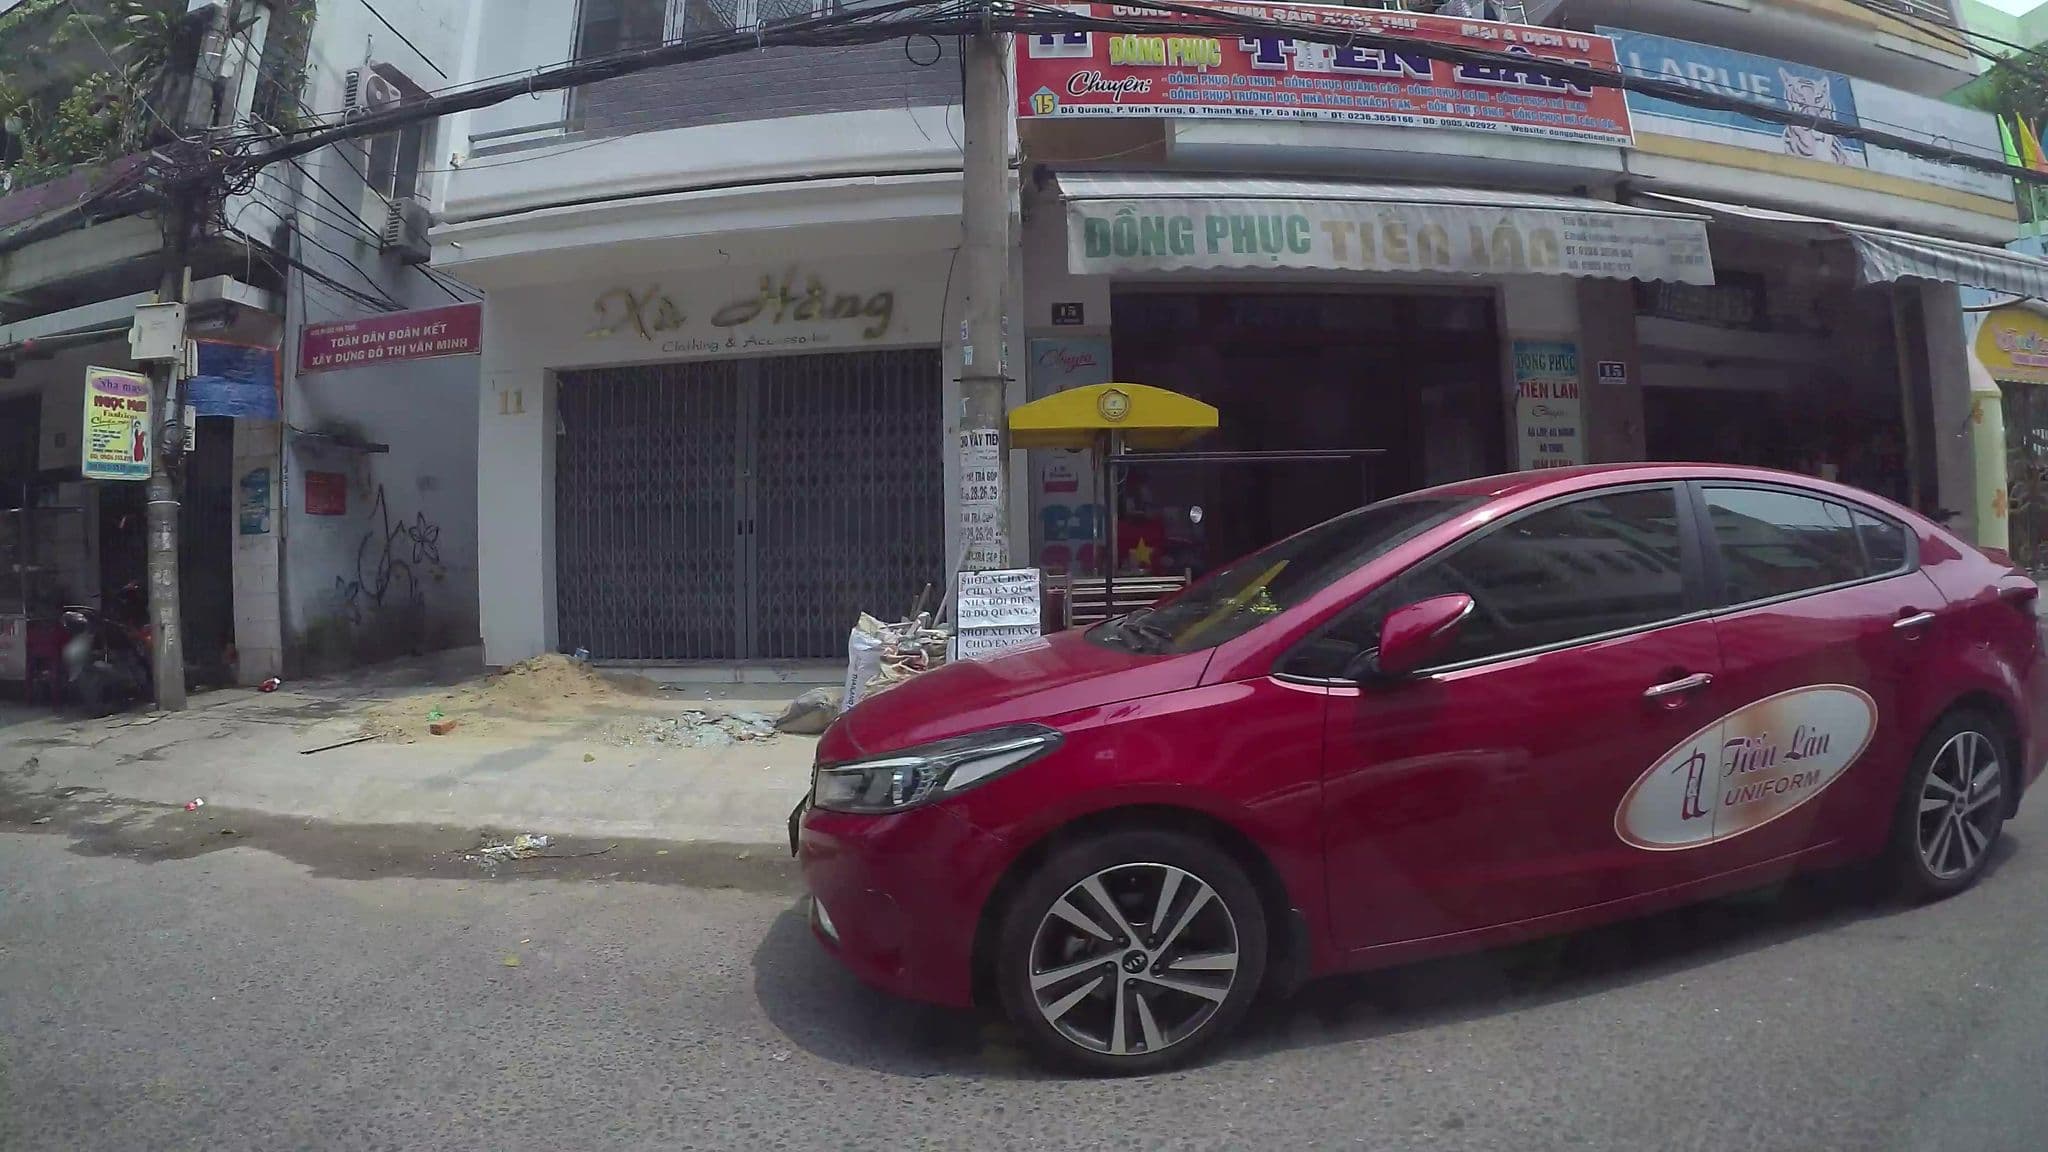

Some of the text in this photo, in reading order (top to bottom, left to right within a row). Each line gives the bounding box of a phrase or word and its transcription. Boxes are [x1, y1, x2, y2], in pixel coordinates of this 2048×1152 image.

[1167, 37, 1222, 72] PHỤC
[1067, 70, 1152, 103] Chuyên:
[1627, 52, 1776, 103] LARUE
[1035, 93, 1055, 115] 15
[1084, 207, 1195, 259] ĐỒNG
[1205, 213, 1311, 262] PHỤC
[423, 320, 448, 336] KẾT
[436, 337, 468, 350] MINH
[661, 335, 719, 353] Clothing
[725, 337, 736, 348] &
[1604, 364, 1623, 377] 15
[499, 388, 527, 415] 11
[961, 576, 987, 584] SHOP
[961, 609, 972, 618] 20
[961, 628, 988, 637] SHOP
[1725, 769, 1821, 807] UNIFORM
